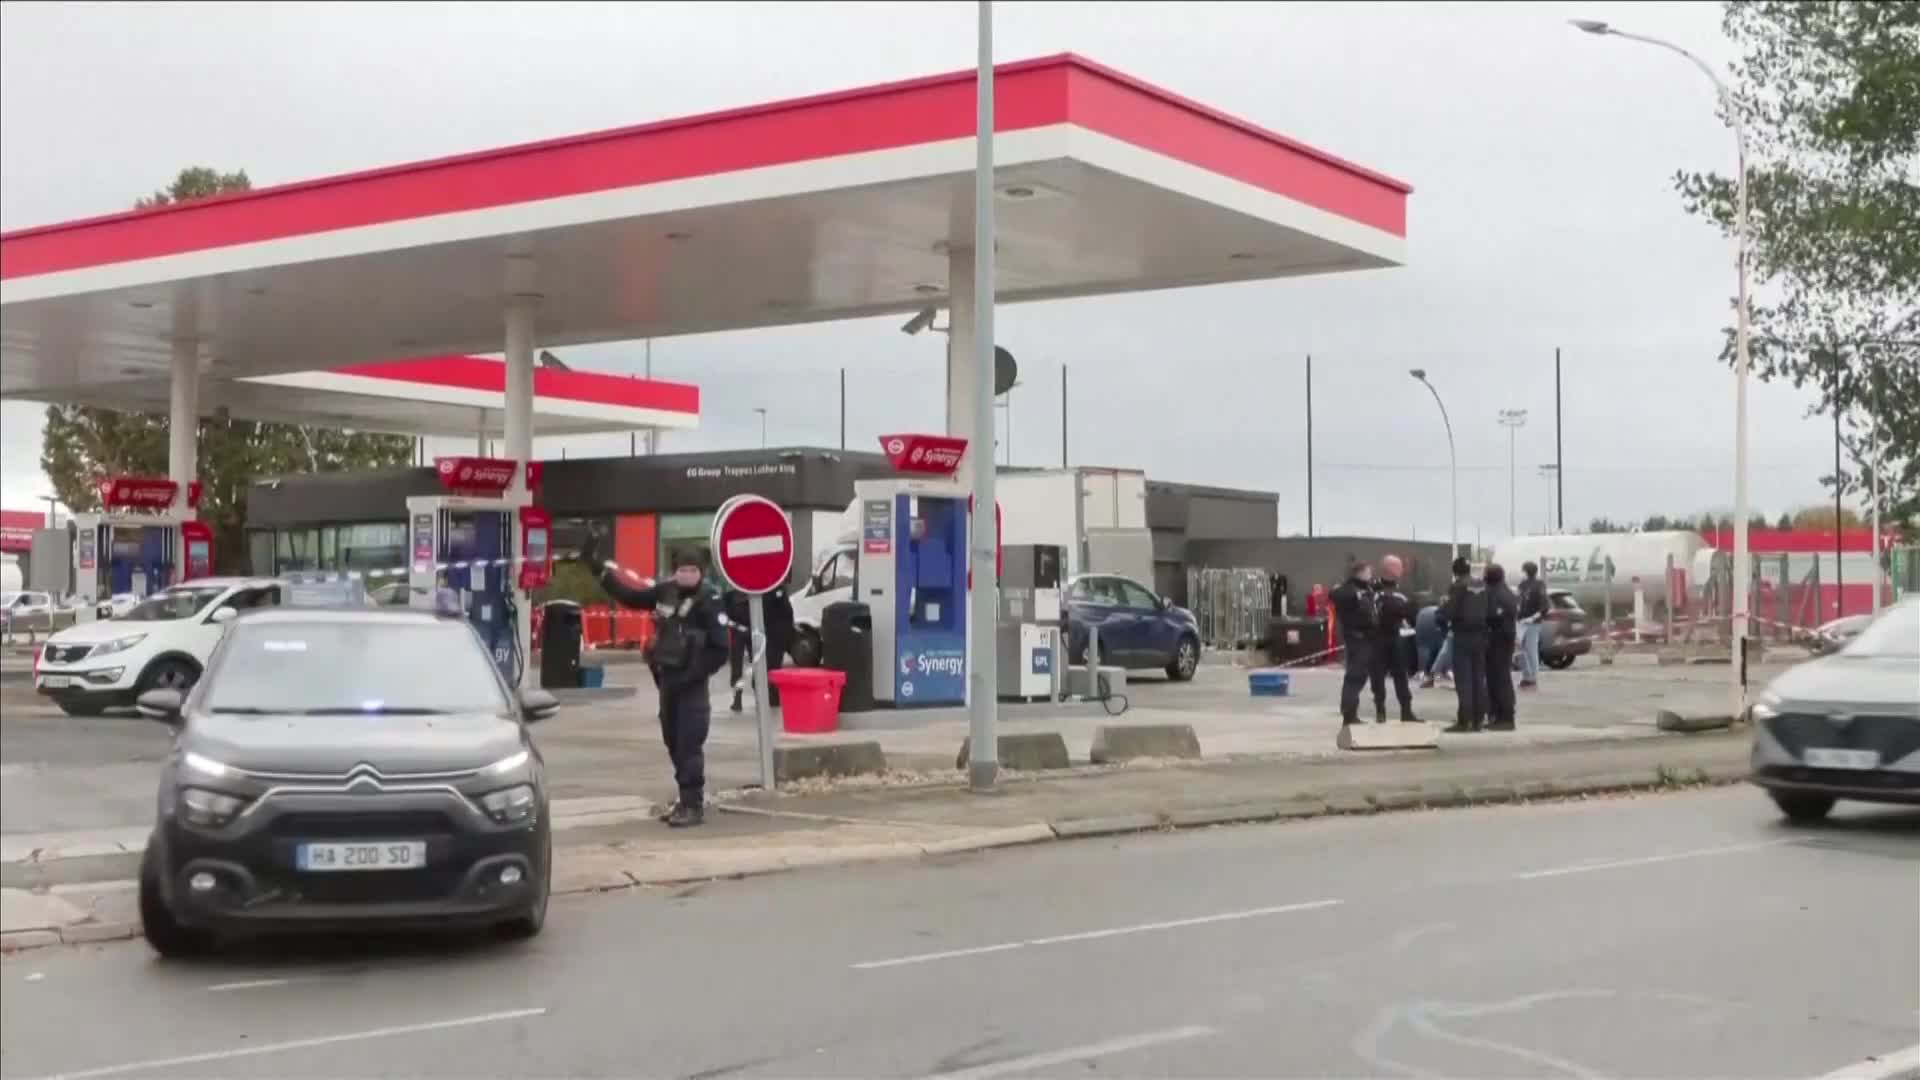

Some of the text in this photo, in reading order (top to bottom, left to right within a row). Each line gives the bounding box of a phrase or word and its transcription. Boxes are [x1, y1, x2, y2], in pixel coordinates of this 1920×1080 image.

[698, 468, 721, 478] Group
[1544, 556, 1580, 573] GAZ
[918, 655, 963, 674] Synergy
